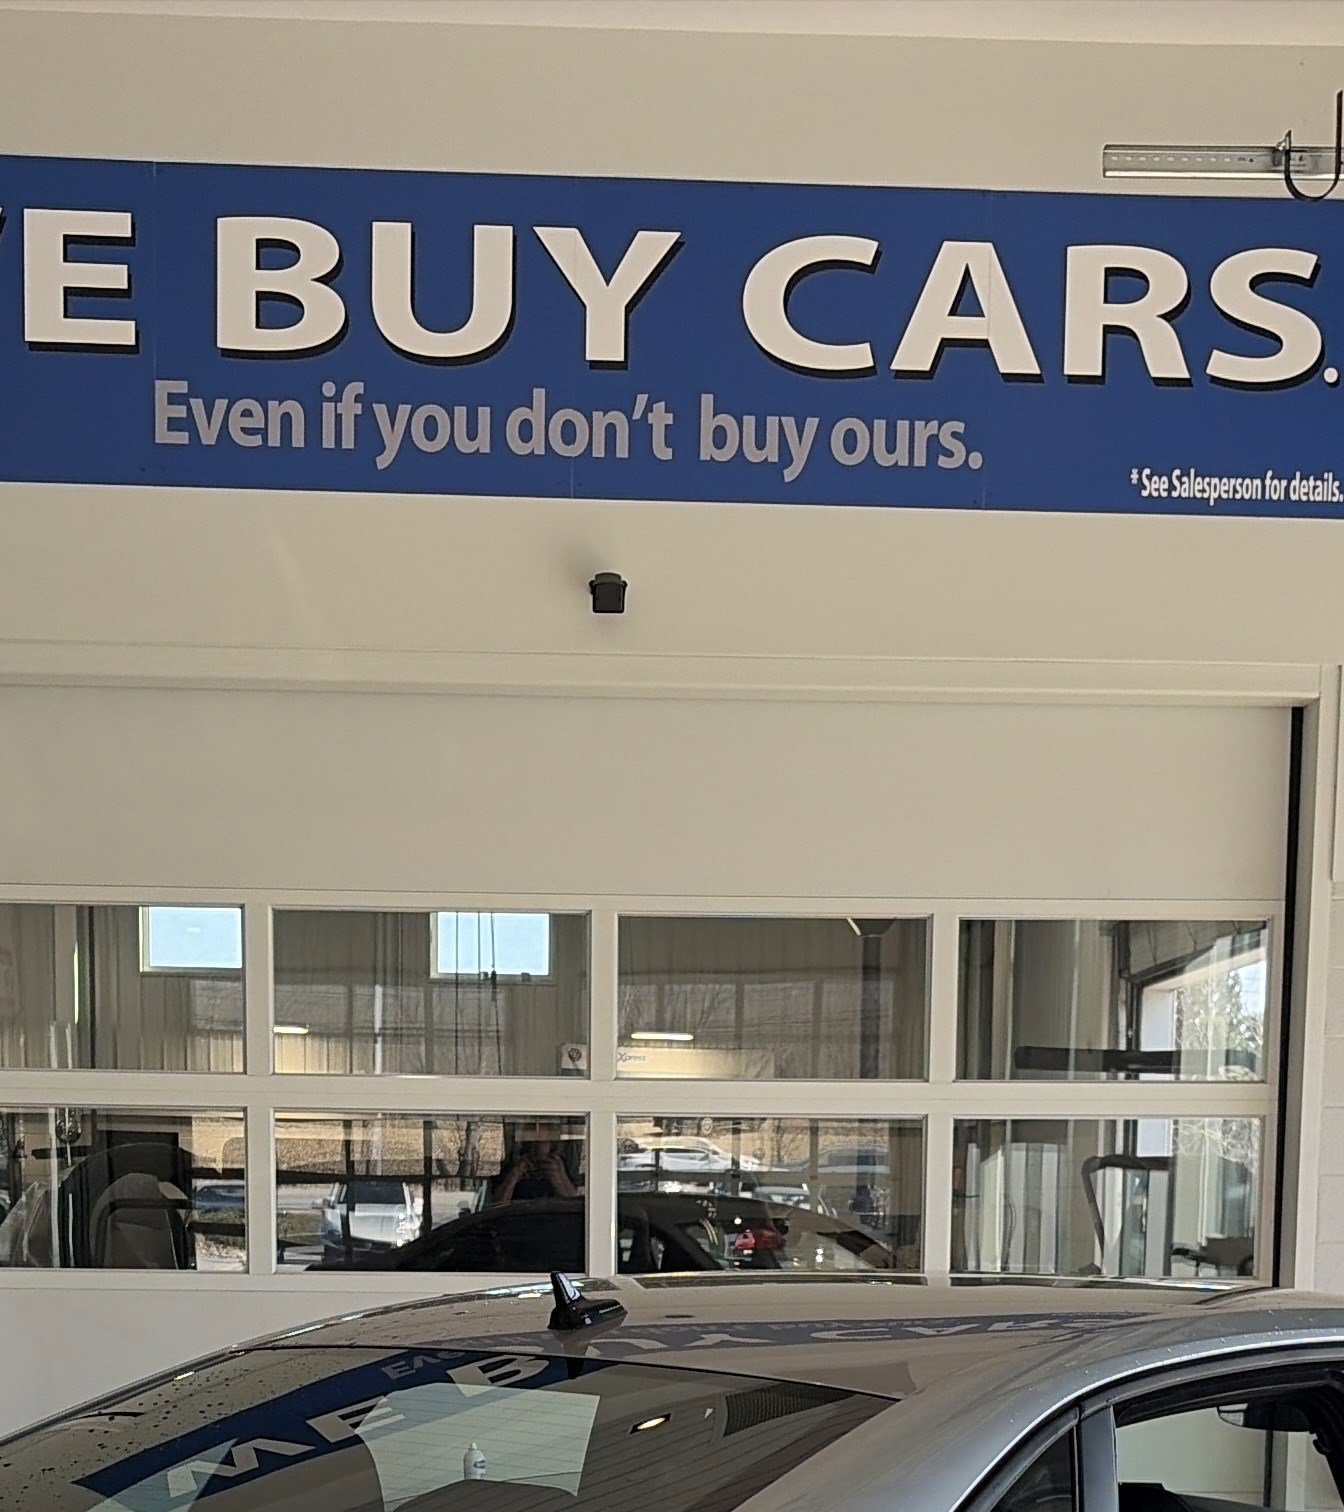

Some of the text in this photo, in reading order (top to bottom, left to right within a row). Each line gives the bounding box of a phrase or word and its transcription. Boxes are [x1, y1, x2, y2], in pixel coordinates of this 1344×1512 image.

[216, 216, 683, 365] BUY
[742, 234, 1340, 386] CARS.
[154, 379, 983, 483] Even if you don't buy ours.
[1171, 467, 1262, 506] Salesperson
[1265, 469, 1288, 501] for
[1289, 470, 1344, 503] details.
